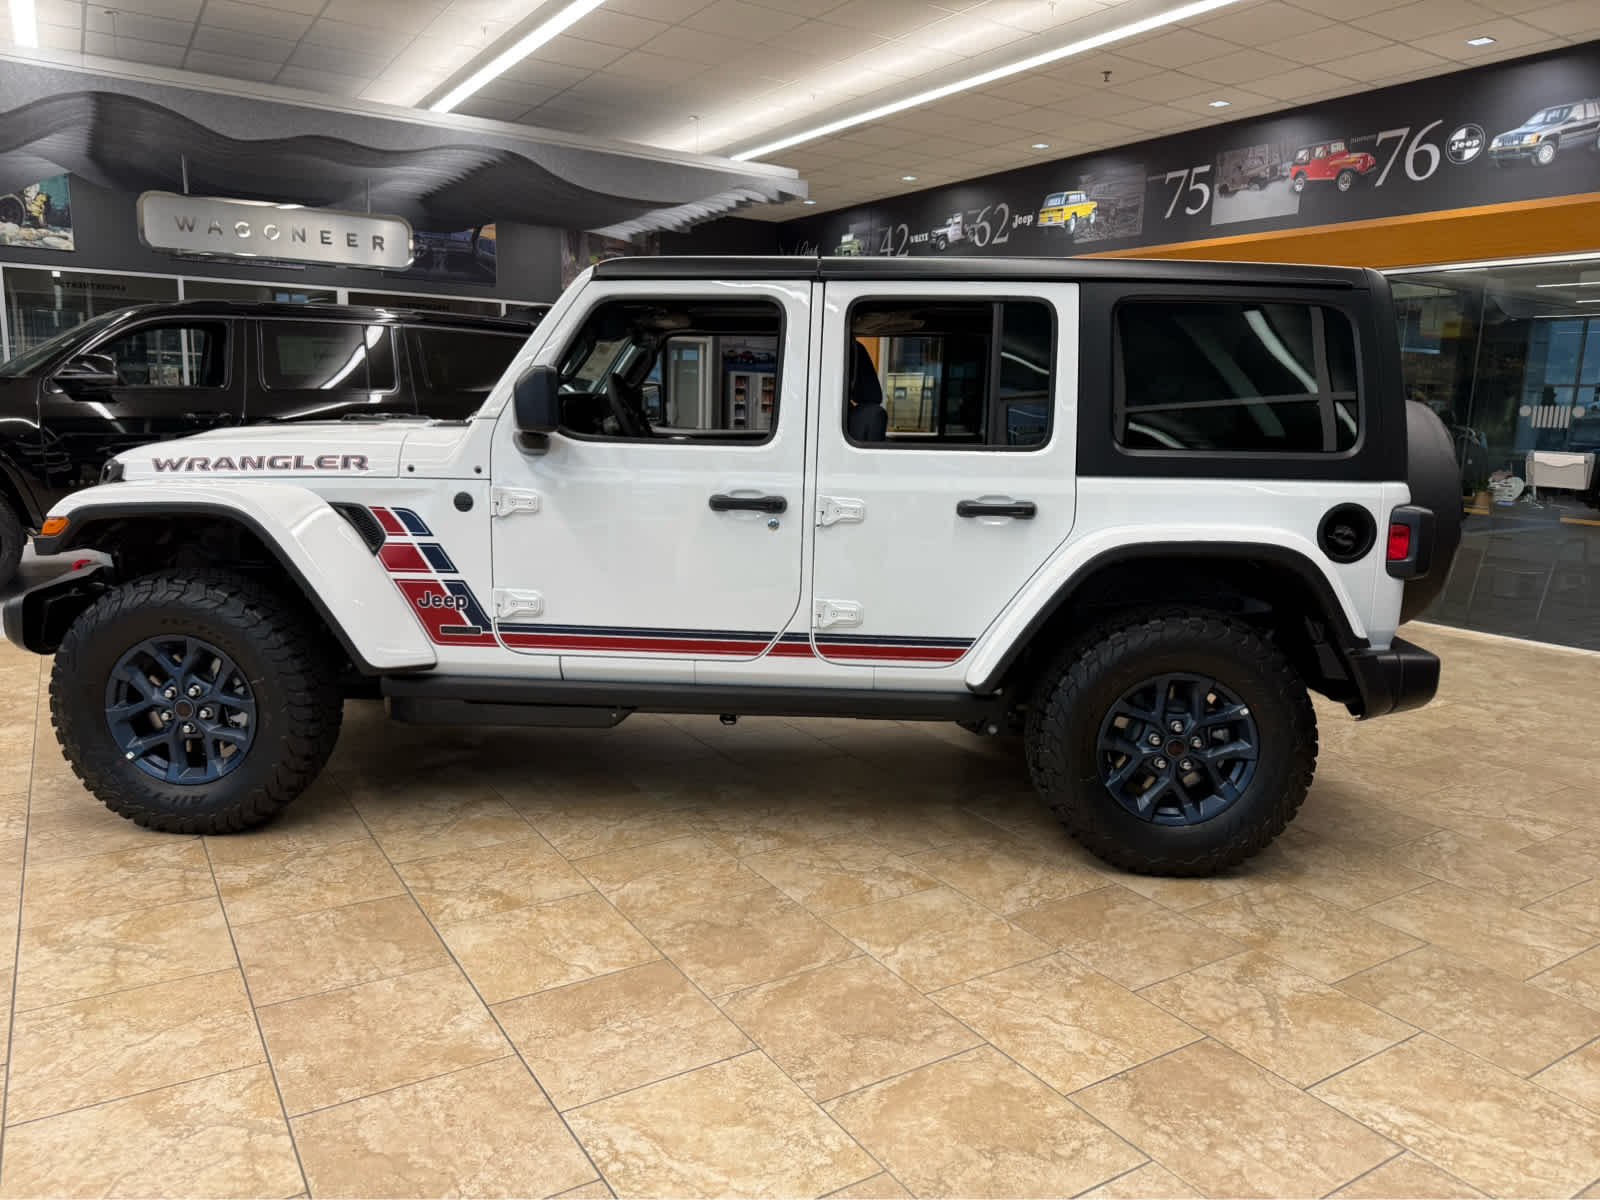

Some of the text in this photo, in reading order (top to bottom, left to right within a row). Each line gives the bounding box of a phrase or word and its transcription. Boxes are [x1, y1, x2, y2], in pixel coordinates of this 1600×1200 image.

[1374, 119, 1443, 187] 76
[1451, 139, 1480, 151] Jeep
[1164, 164, 1211, 219] 75
[174, 215, 386, 252] WAGONEER
[974, 202, 1010, 247] 62
[1012, 213, 1034, 229] Jeep
[880, 223, 910, 257] 42
[152, 455, 369, 473] WRANGLER
[417, 590, 469, 611] Jeep
